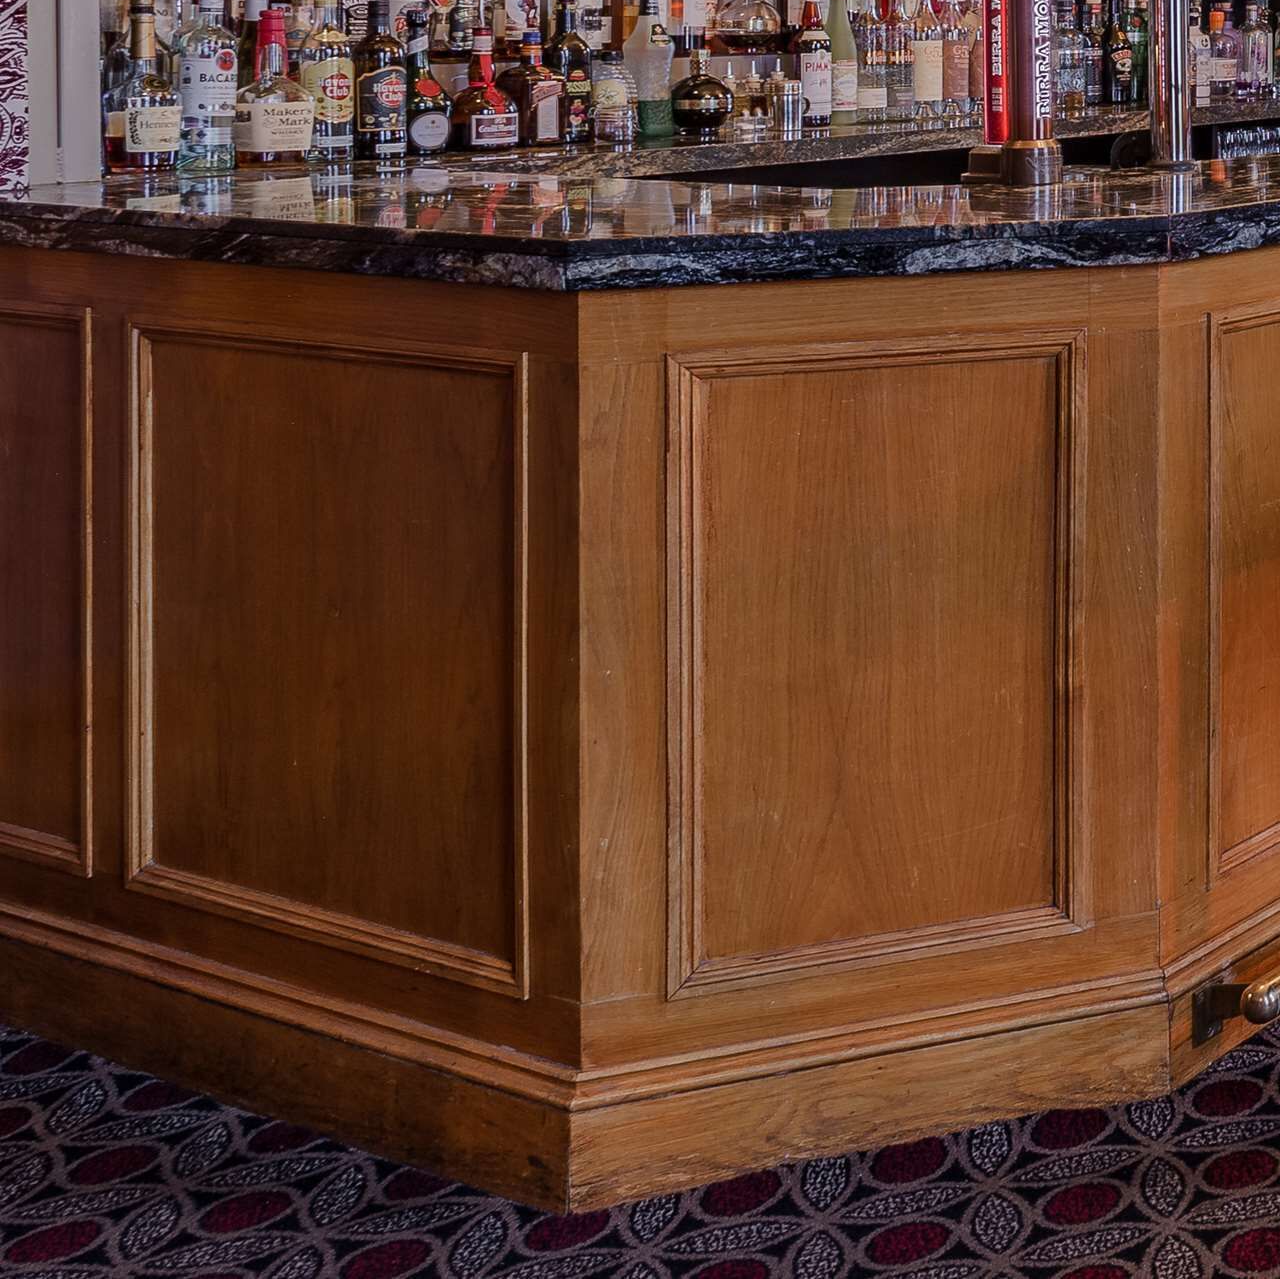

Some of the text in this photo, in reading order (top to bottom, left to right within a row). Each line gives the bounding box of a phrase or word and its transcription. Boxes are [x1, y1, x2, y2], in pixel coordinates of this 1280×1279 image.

[991, 14, 1003, 77] BIRRA
[326, 86, 350, 96] Club
[1036, 41, 1051, 119] BIRRA
